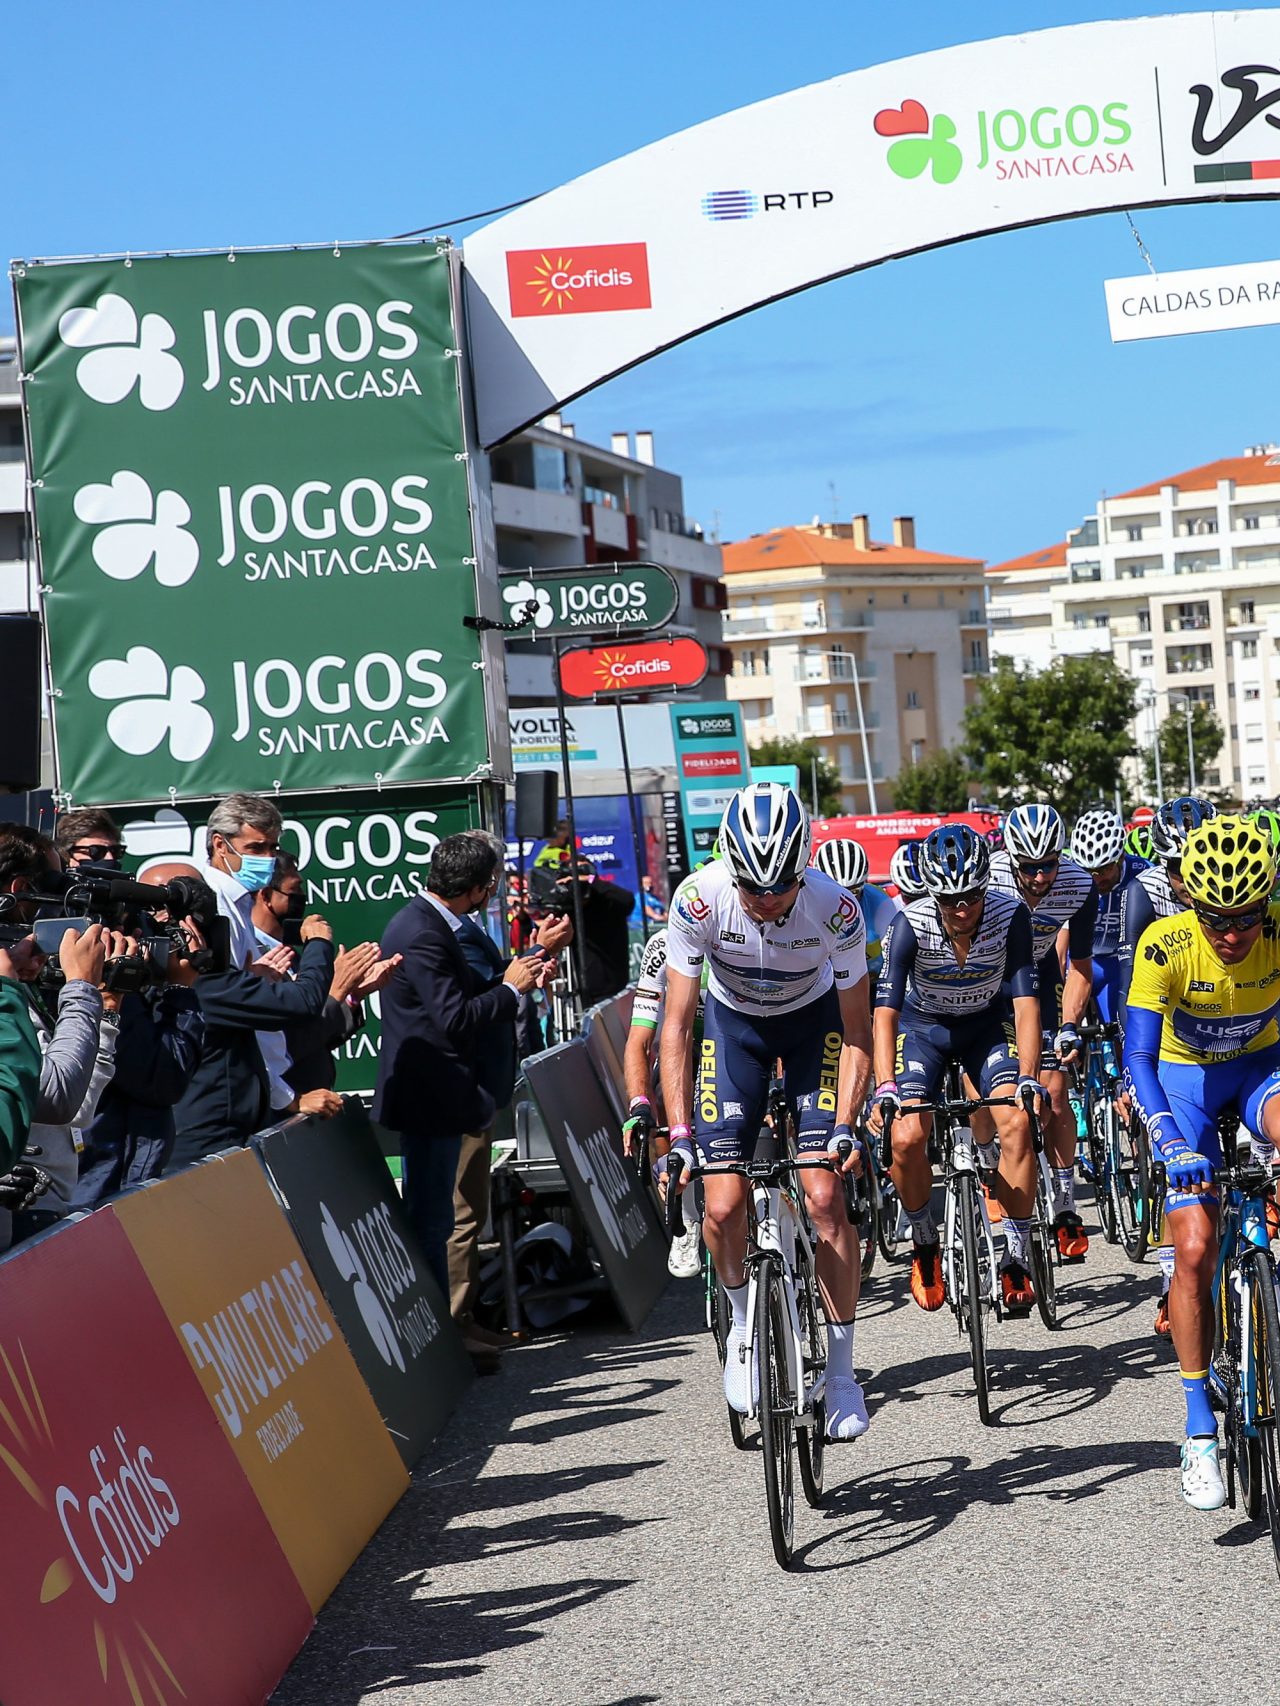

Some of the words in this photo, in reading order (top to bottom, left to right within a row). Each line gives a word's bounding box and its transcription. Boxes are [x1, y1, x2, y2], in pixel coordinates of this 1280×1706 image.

[976, 102, 1132, 170] JOGOS
[995, 151, 1135, 182] SANTACASA
[763, 190, 834, 212] RTP
[551, 267, 633, 290] Cofidis
[1121, 289, 1212, 317] CALDAS
[1218, 285, 1251, 306] DA
[202, 301, 419, 391] JOGOS
[229, 367, 423, 407] SANTACASA
[216, 474, 434, 568] JOGOS
[244, 542, 438, 582] SANTACASA
[559, 580, 648, 622] JOGOS
[570, 609, 649, 627] SANTACASA
[610, 658, 671, 678] Cofidis
[231, 648, 448, 742] JOGOS
[258, 716, 450, 757] SANTACASA
[700, 718, 732, 731] JOGOS
[281, 811, 441, 871] OGOS
[855, 817, 941, 829] BOMBEIROS
[876, 827, 917, 835] ANADIA
[721, 931, 744, 943] P&R
[942, 990, 994, 1005] NIPPO
[1190, 981, 1213, 992] P&R
[700, 1039, 718, 1123] DELKO
[817, 1031, 843, 1112] DELKO
[1129, 1084, 1148, 1124] Porto
[352, 1202, 416, 1339] JOGOS
[203, 1260, 333, 1414] MULTICARE
[55, 1426, 180, 1603] Cofidis
